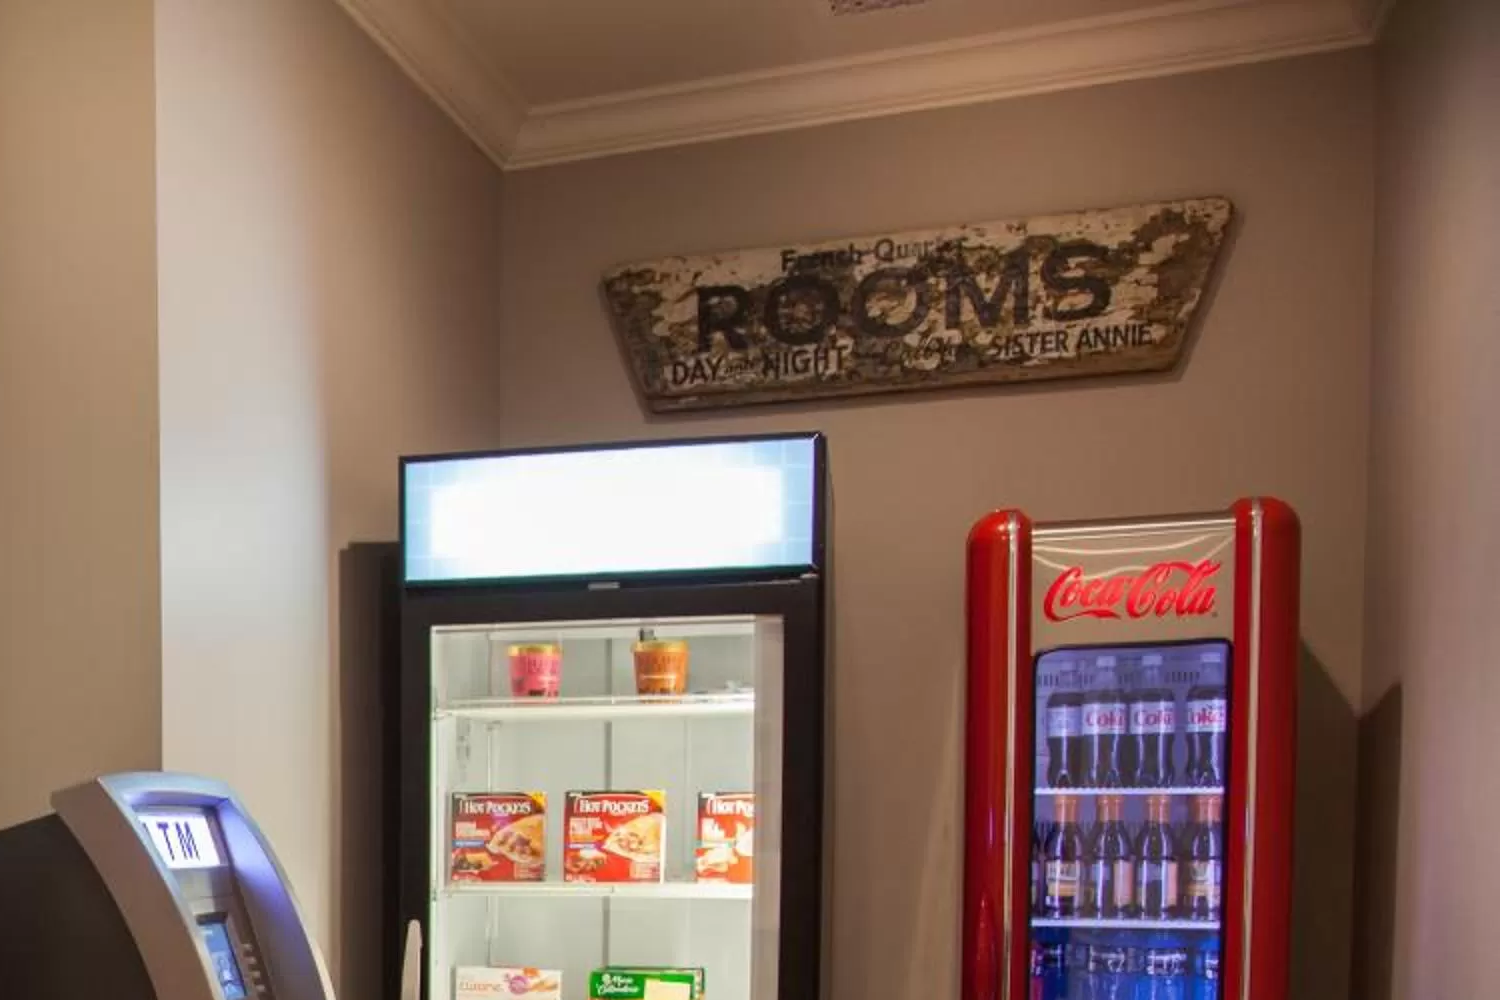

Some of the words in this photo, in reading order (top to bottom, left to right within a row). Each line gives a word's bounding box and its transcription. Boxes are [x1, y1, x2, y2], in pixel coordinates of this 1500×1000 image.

[697, 237, 1112, 356] ROOMS
[671, 350, 722, 387] DAY
[761, 341, 848, 380] NIGHT
[992, 328, 1068, 361] SISTER
[1076, 321, 1156, 352] ANNIE
[1043, 559, 1220, 622] Coca-Cola
[142, 821, 201, 861] TM
